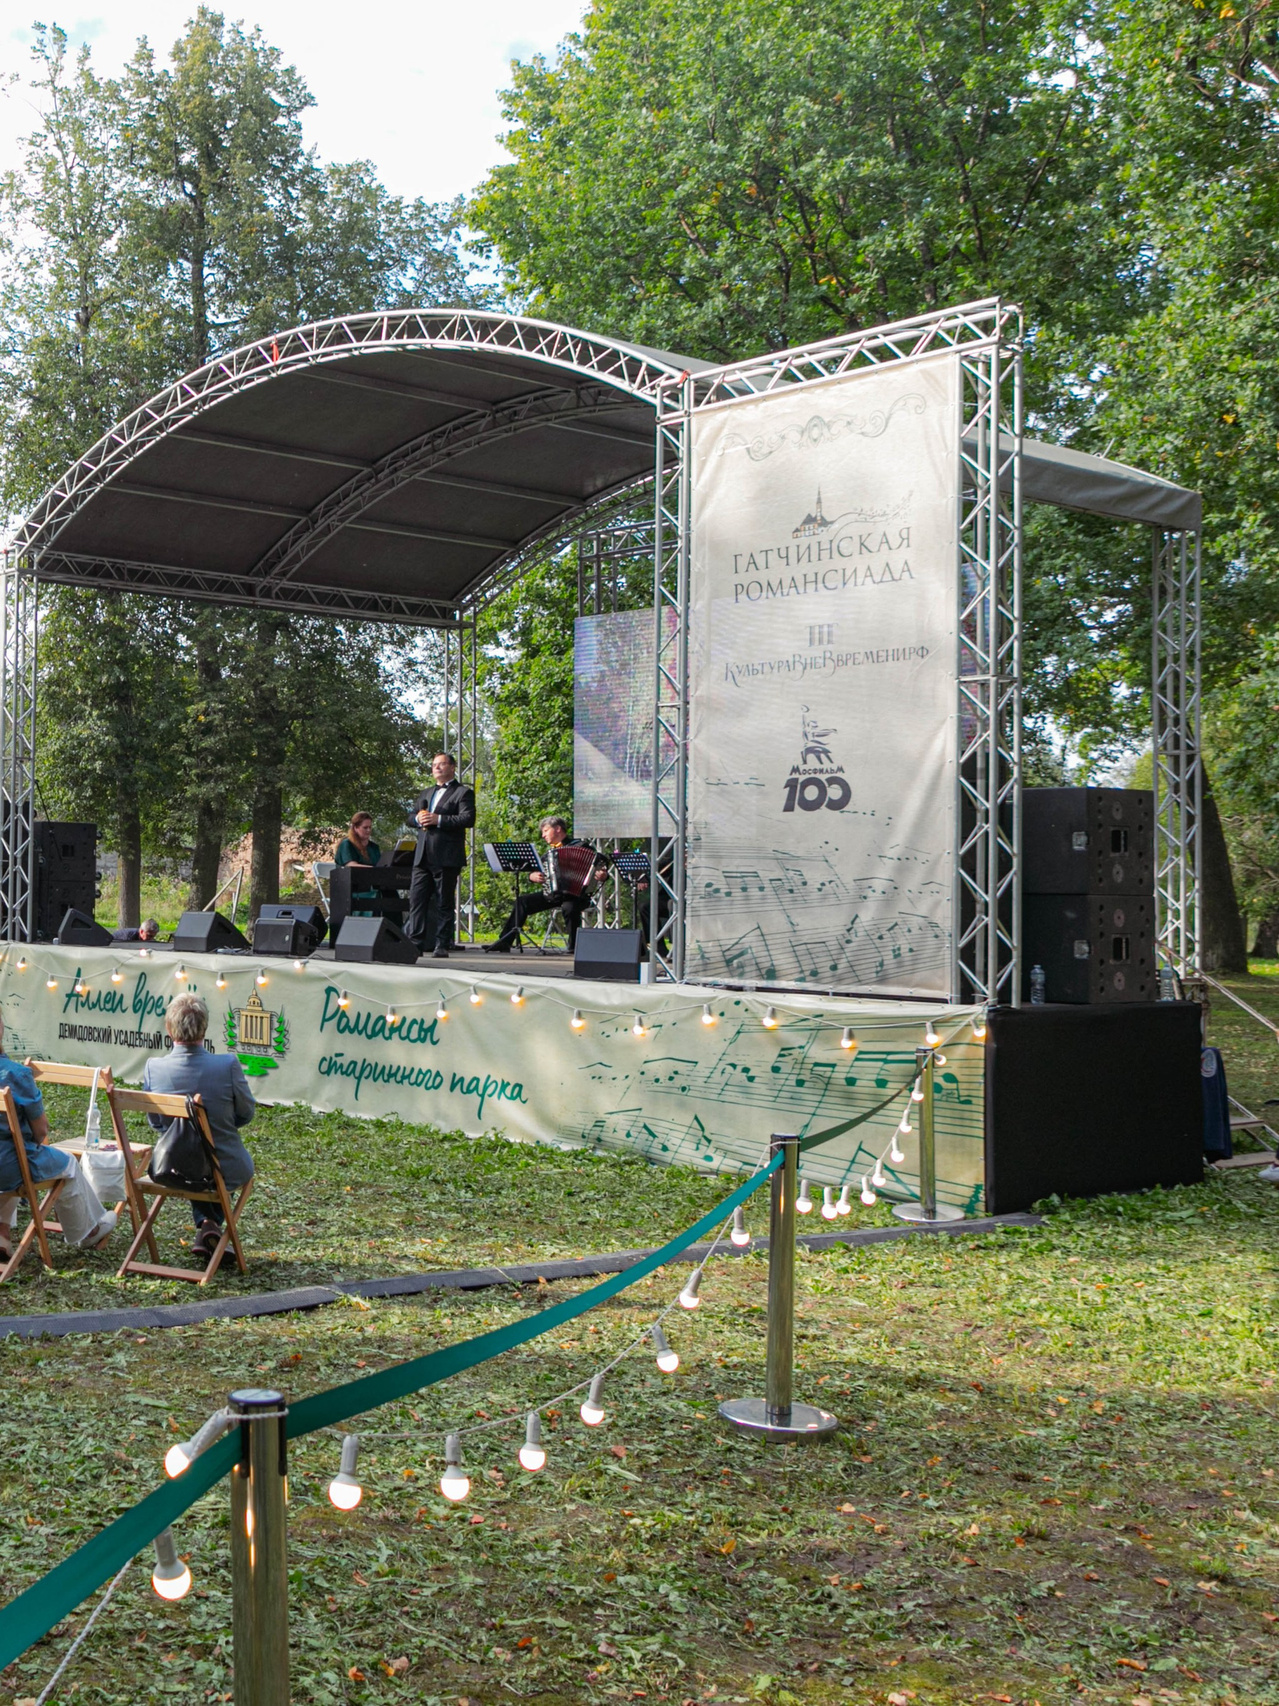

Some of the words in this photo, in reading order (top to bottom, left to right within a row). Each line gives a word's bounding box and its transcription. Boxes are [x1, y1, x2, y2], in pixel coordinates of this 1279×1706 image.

[733, 527, 912, 574] ГАТЧИНСКАЯ
[733, 560, 915, 603] РОМАНСИАДА
[783, 776, 852, 812] 100
[58, 1022, 113, 1043] ДЕМИДОВСКИЙ
[113, 1028, 163, 1050] УСАДЕБНЫЙ
[320, 985, 441, 1046] Романсы
[318, 1052, 444, 1101] старинного
[449, 1072, 529, 1120] парка
